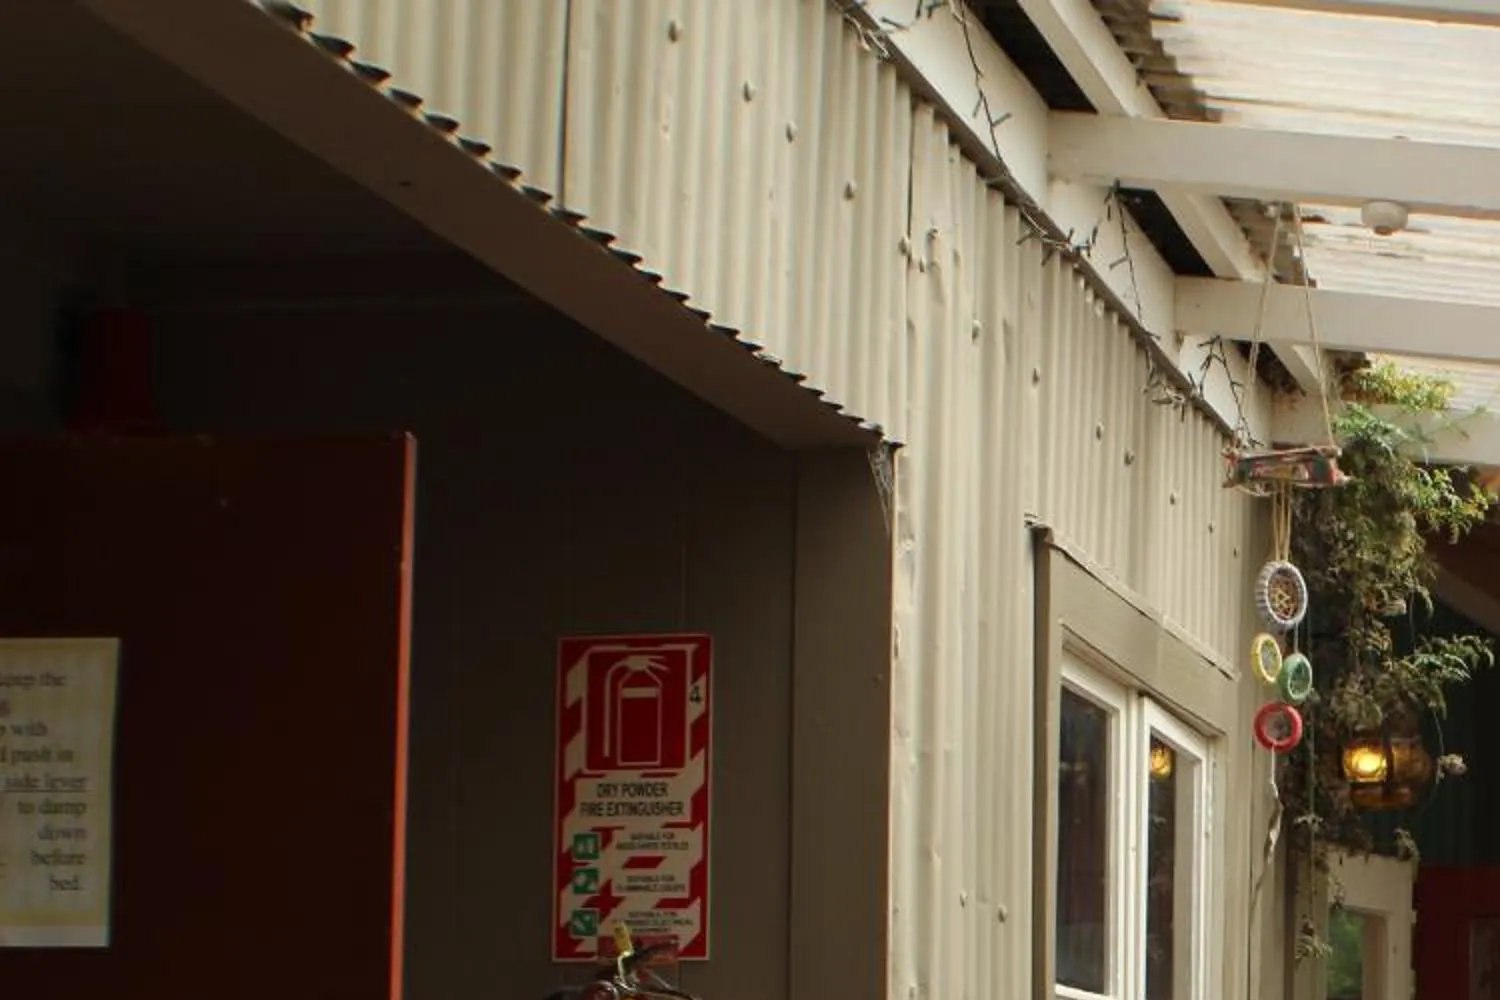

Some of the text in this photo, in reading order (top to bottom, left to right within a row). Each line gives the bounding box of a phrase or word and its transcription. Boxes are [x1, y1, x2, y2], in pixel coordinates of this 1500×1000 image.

[596, 782, 669, 798] DRY POWDER
[580, 801, 684, 817] FIRE EXTINGUISHER
